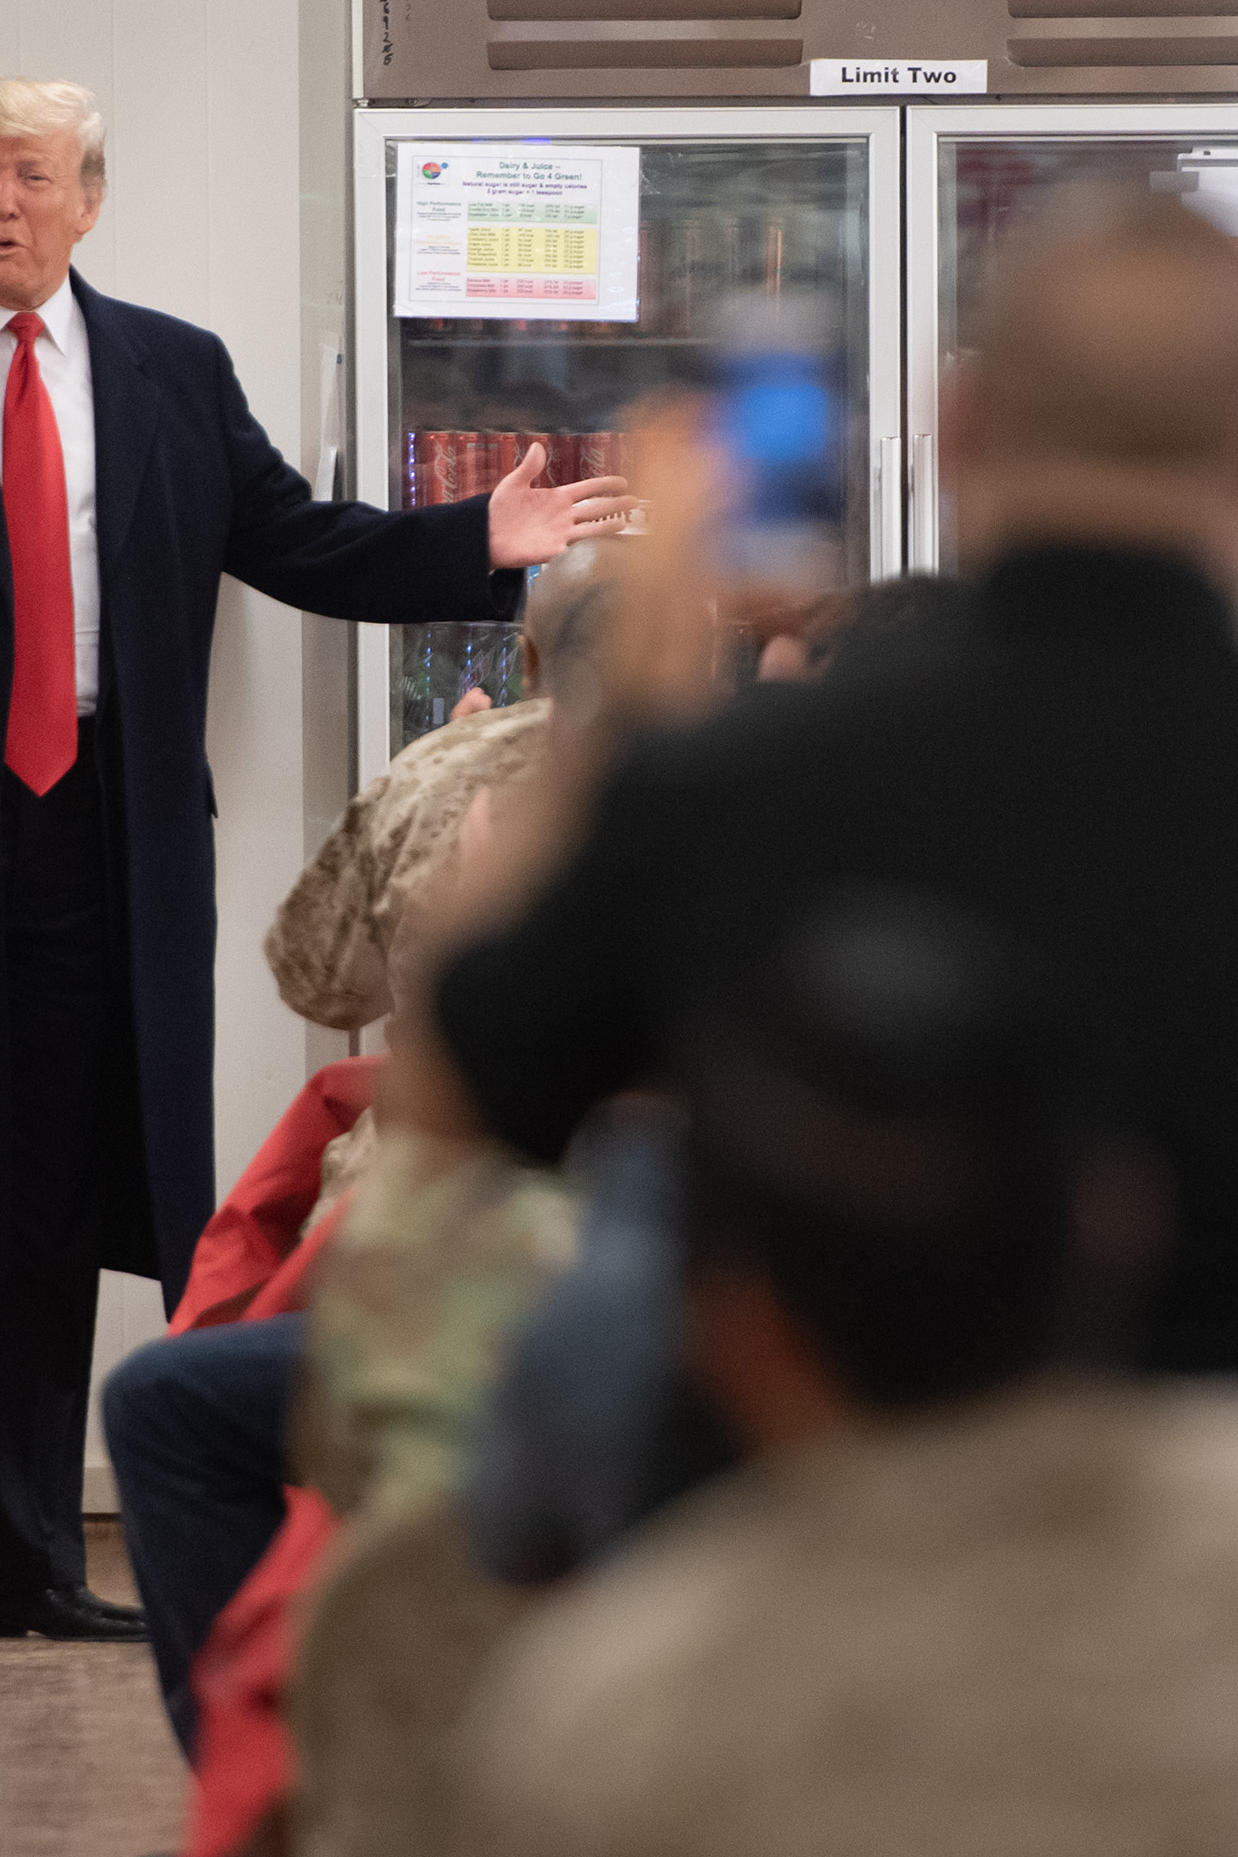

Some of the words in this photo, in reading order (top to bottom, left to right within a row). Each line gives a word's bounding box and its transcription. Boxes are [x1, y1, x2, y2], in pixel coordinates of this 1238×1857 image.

[841, 67, 900, 84] Limit
[907, 67, 957, 84] Two
[499, 161, 520, 171] Dairy
[522, 162, 529, 170] &
[531, 162, 553, 170] Juice
[476, 171, 520, 179] Remember
[523, 172, 531, 180] to
[533, 172, 545, 180] Go
